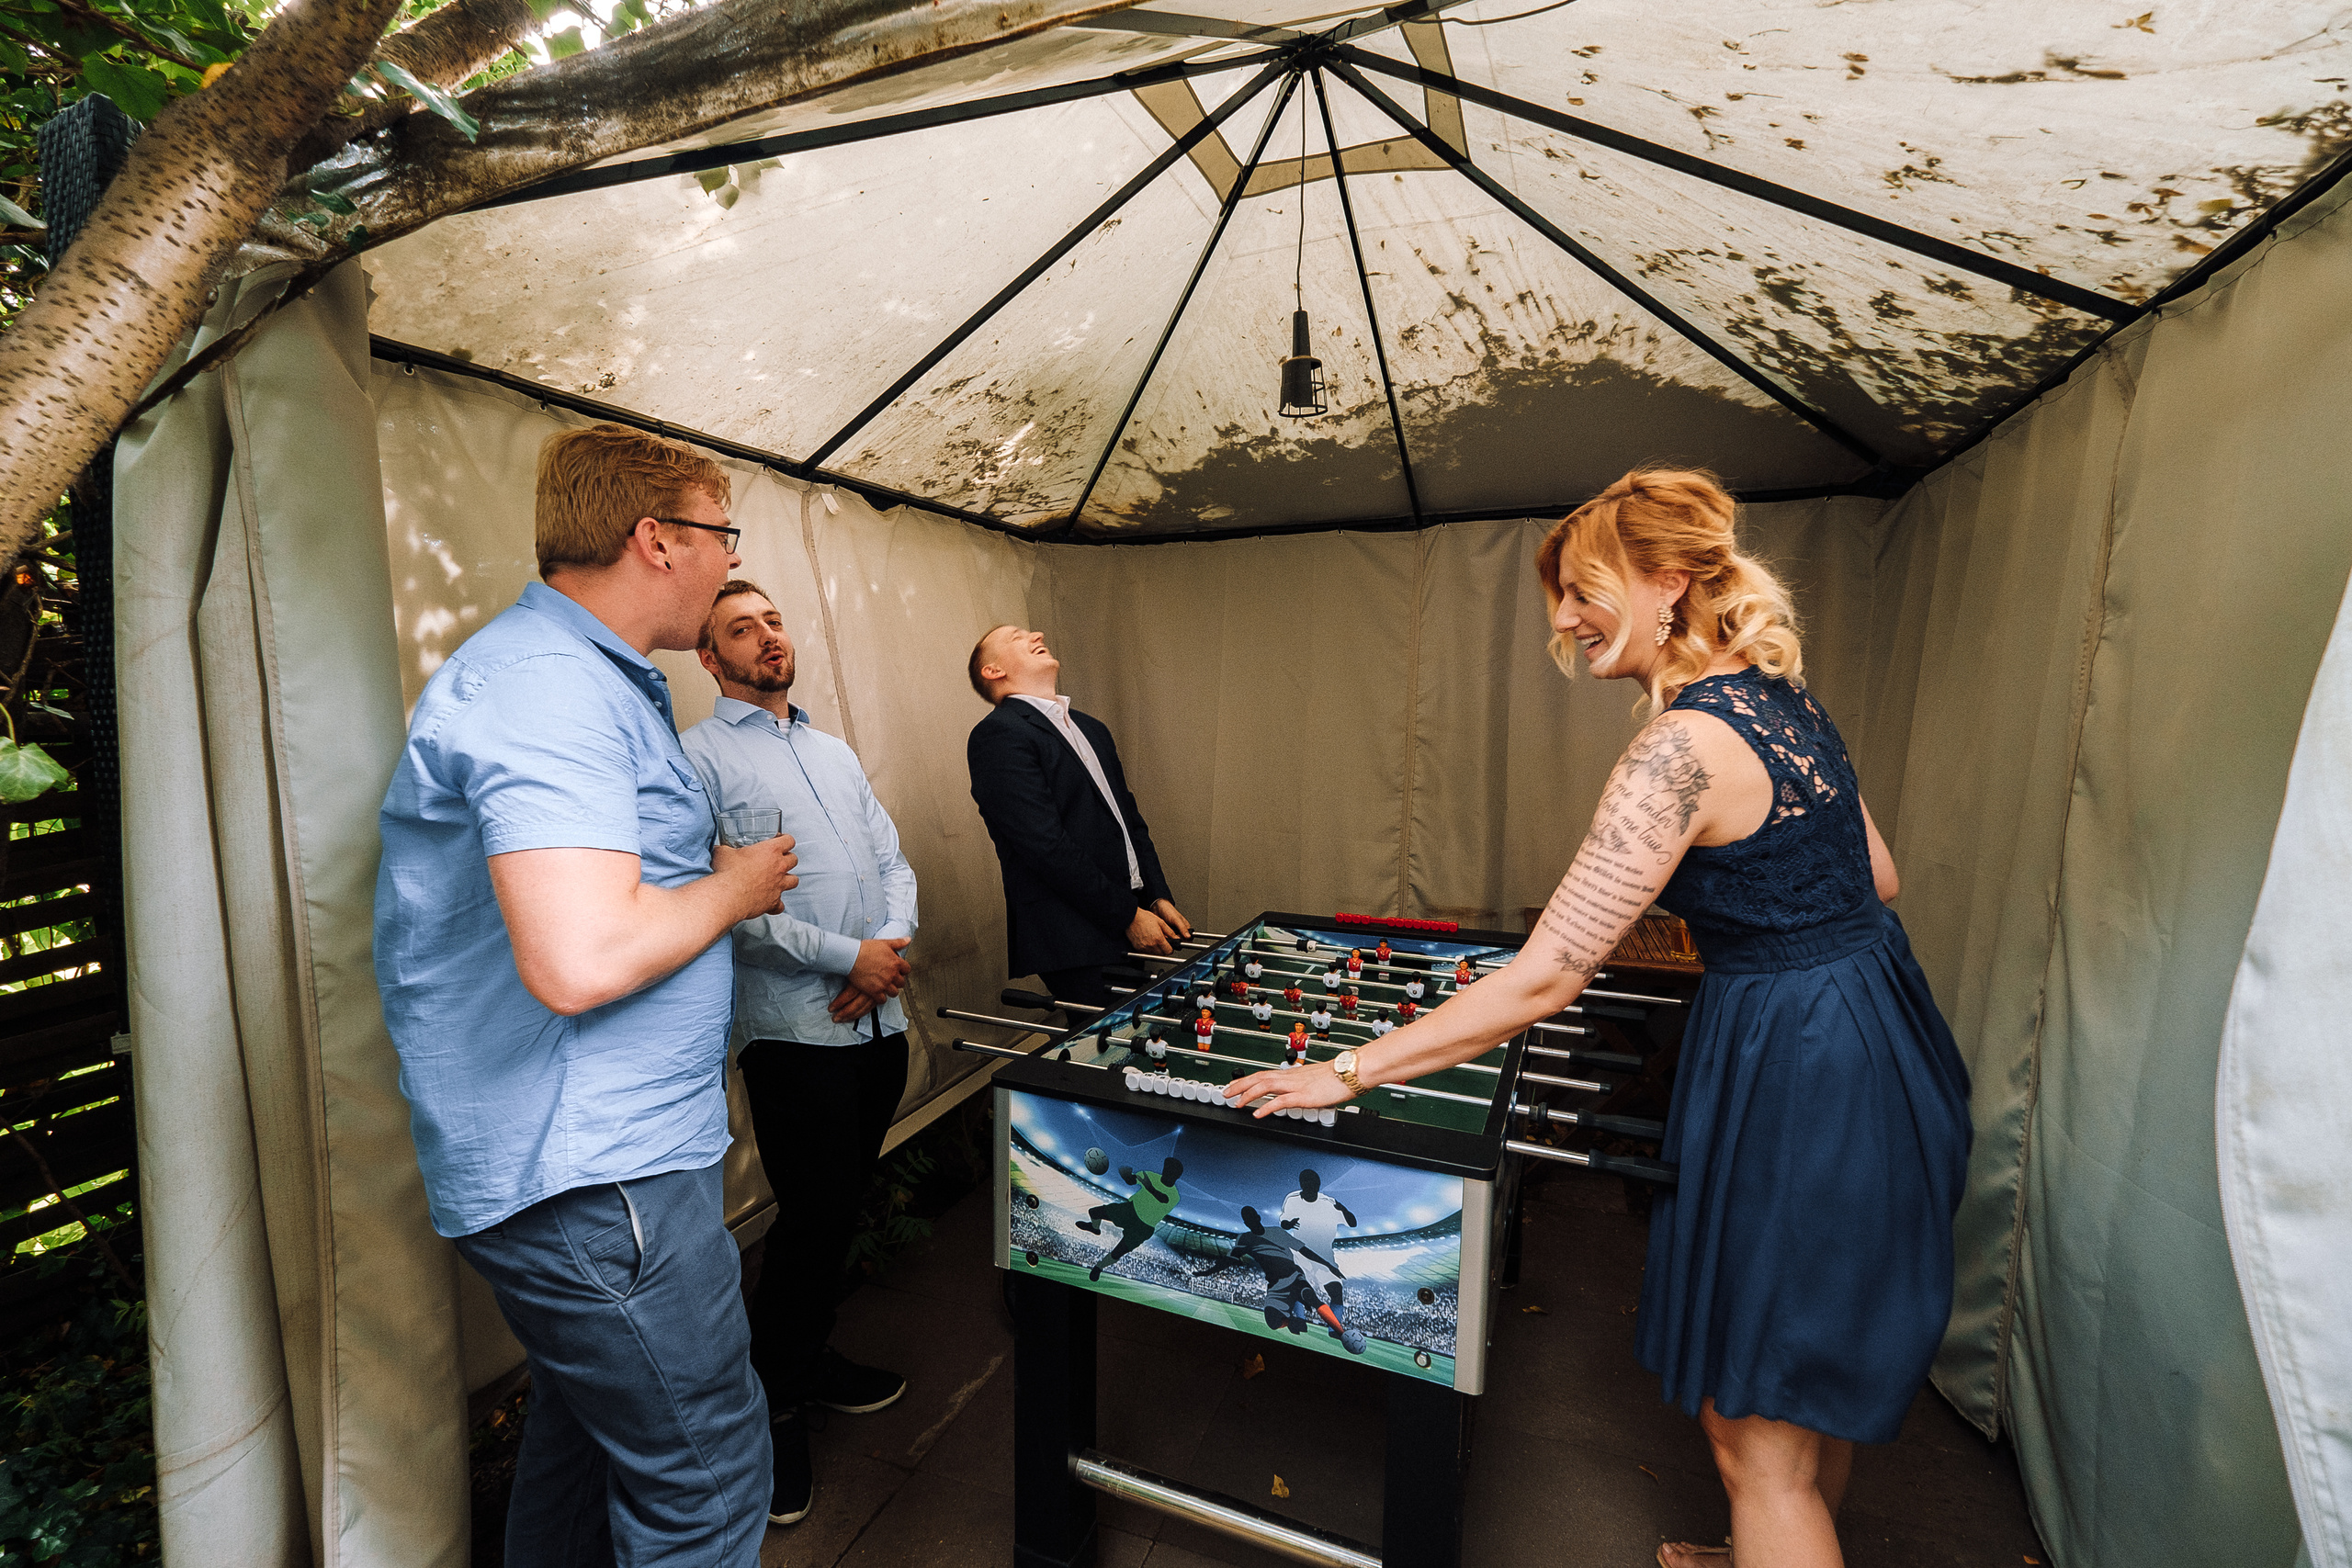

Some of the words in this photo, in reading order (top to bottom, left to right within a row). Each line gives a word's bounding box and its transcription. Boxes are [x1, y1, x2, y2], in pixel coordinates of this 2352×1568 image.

[1613, 783, 1634, 799] me
[1636, 792, 1676, 829] tender
[1620, 816, 1639, 833] me
